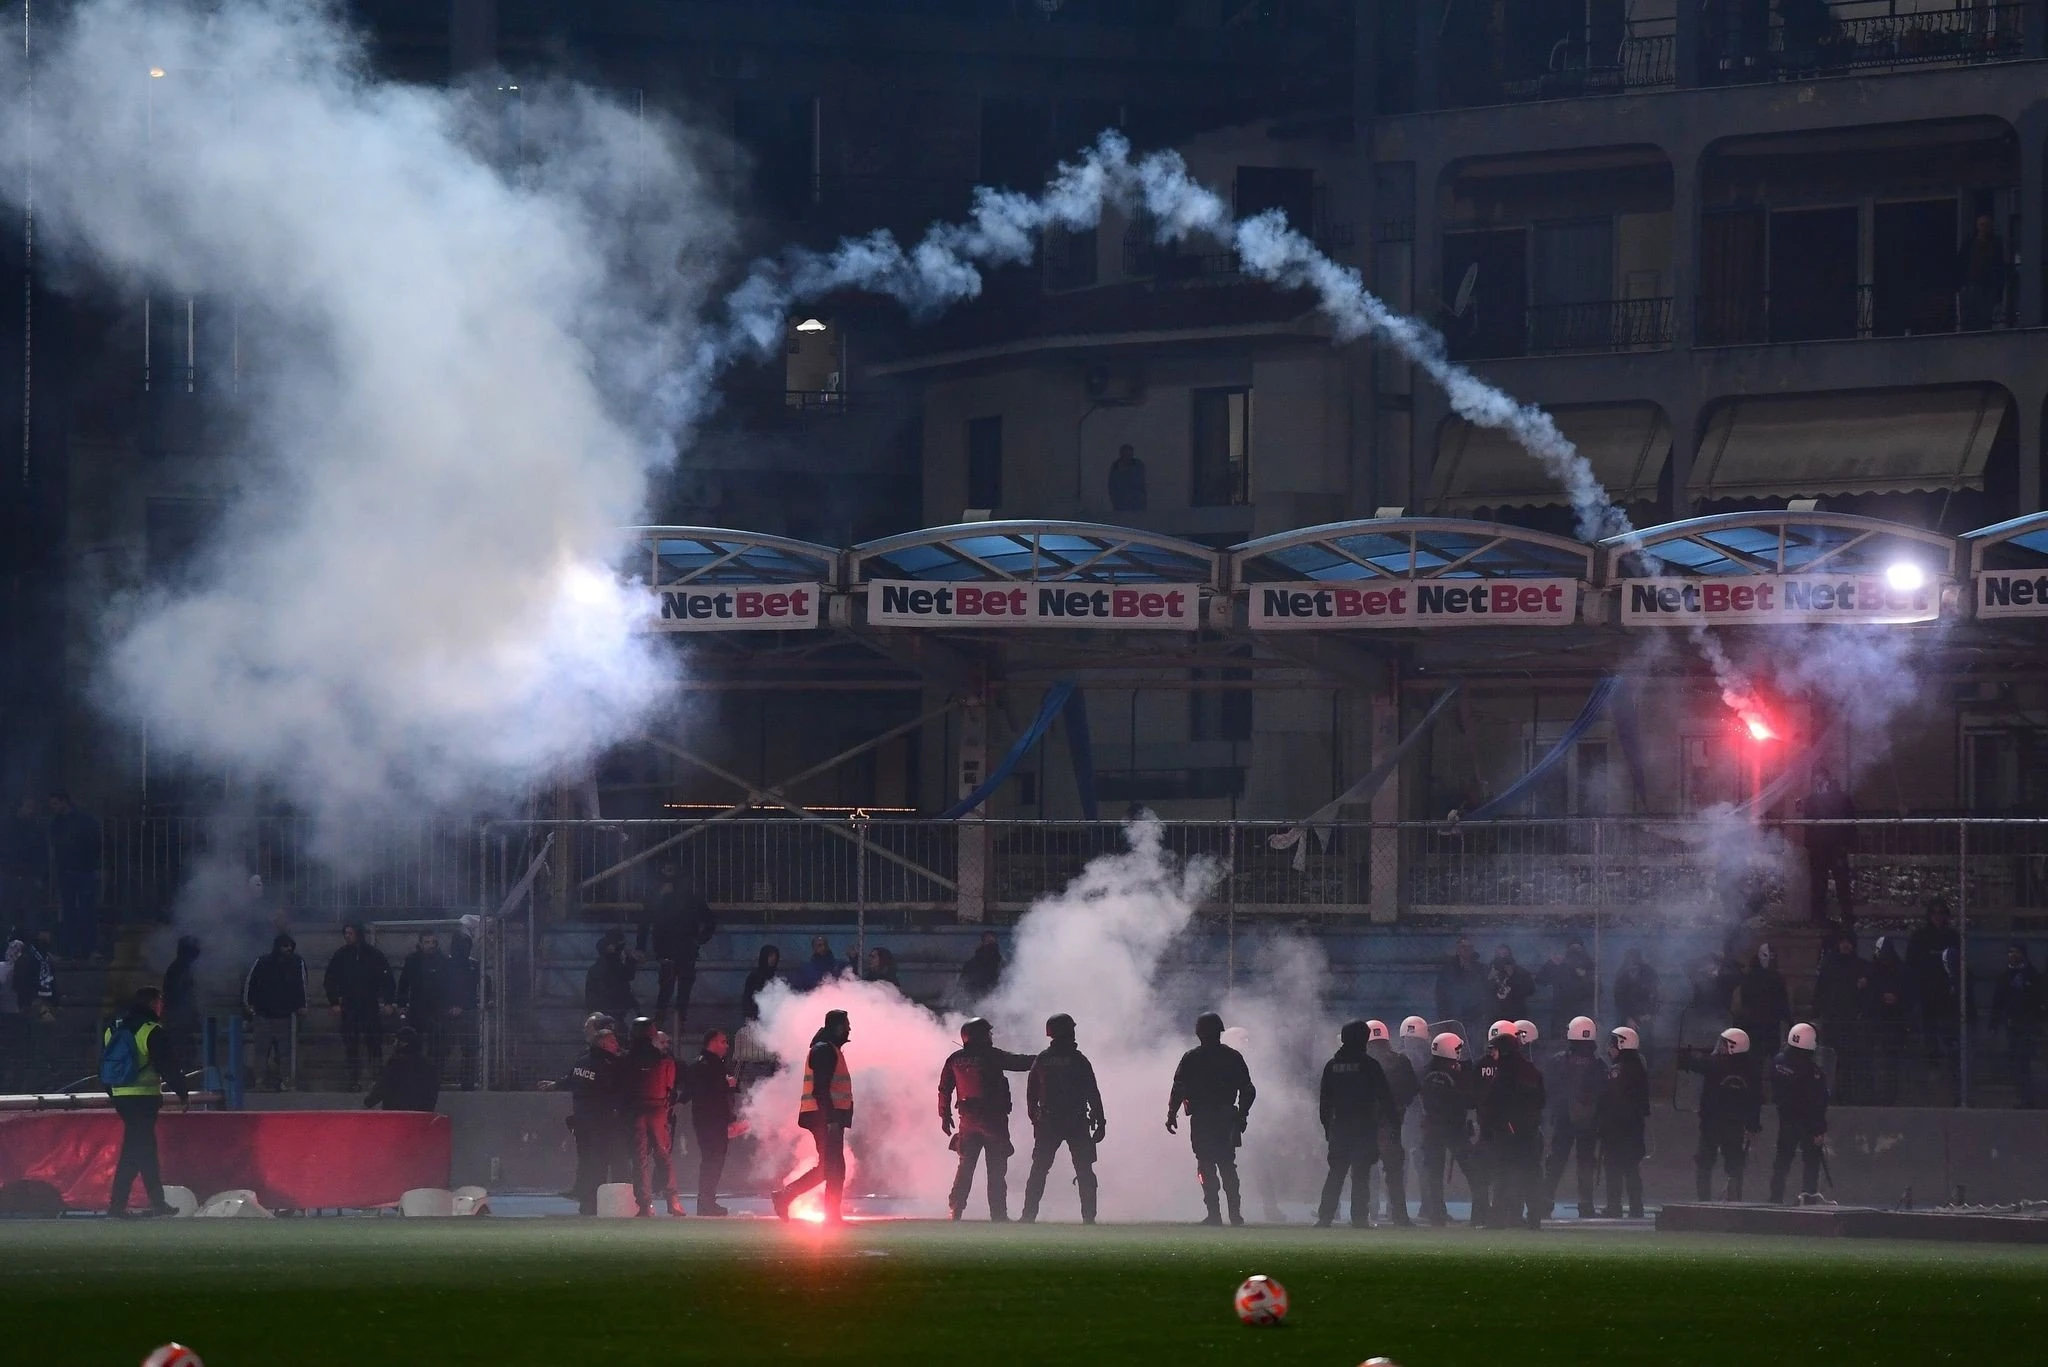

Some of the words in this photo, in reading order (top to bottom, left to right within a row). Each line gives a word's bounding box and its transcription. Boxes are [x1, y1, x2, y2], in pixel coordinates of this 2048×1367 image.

[660, 589, 809, 620] NetBet
[882, 586, 1028, 616] NetBet
[1038, 587, 1185, 618] NetBet
[1263, 587, 1407, 617] NetBet
[1417, 584, 1562, 614] NetBet
[1631, 581, 1774, 613] NetBet
[573, 1067, 596, 1080] POLICE
